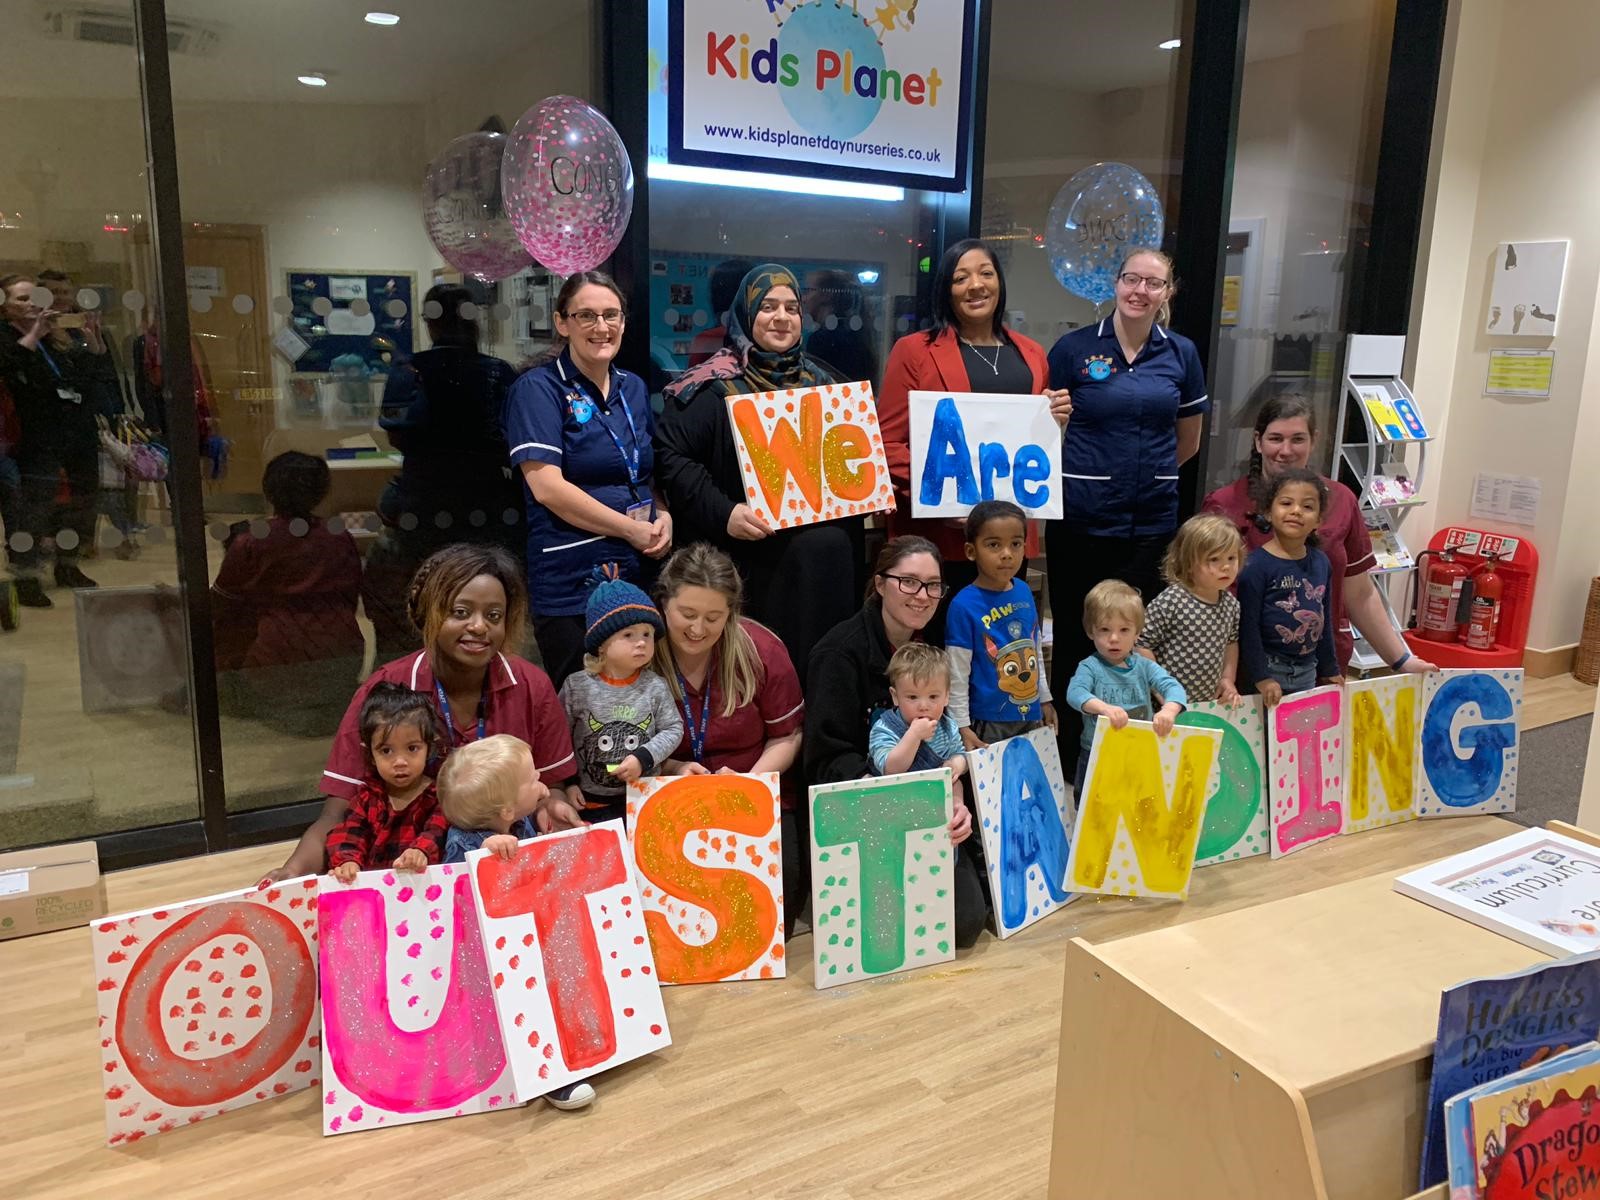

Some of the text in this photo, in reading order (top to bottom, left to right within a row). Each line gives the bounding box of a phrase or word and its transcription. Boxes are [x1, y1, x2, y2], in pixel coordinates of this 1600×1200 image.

[707, 31, 799, 87] Kids
[816, 49, 942, 107] Planet
[704, 124, 941, 162] www.kidsplanetdaynurseries.co.uk
[551, 157, 620, 195] CONG
[732, 391, 1051, 521] We Are
[981, 602, 1013, 629] PAW
[1475, 860, 1600, 908] Curriculum
